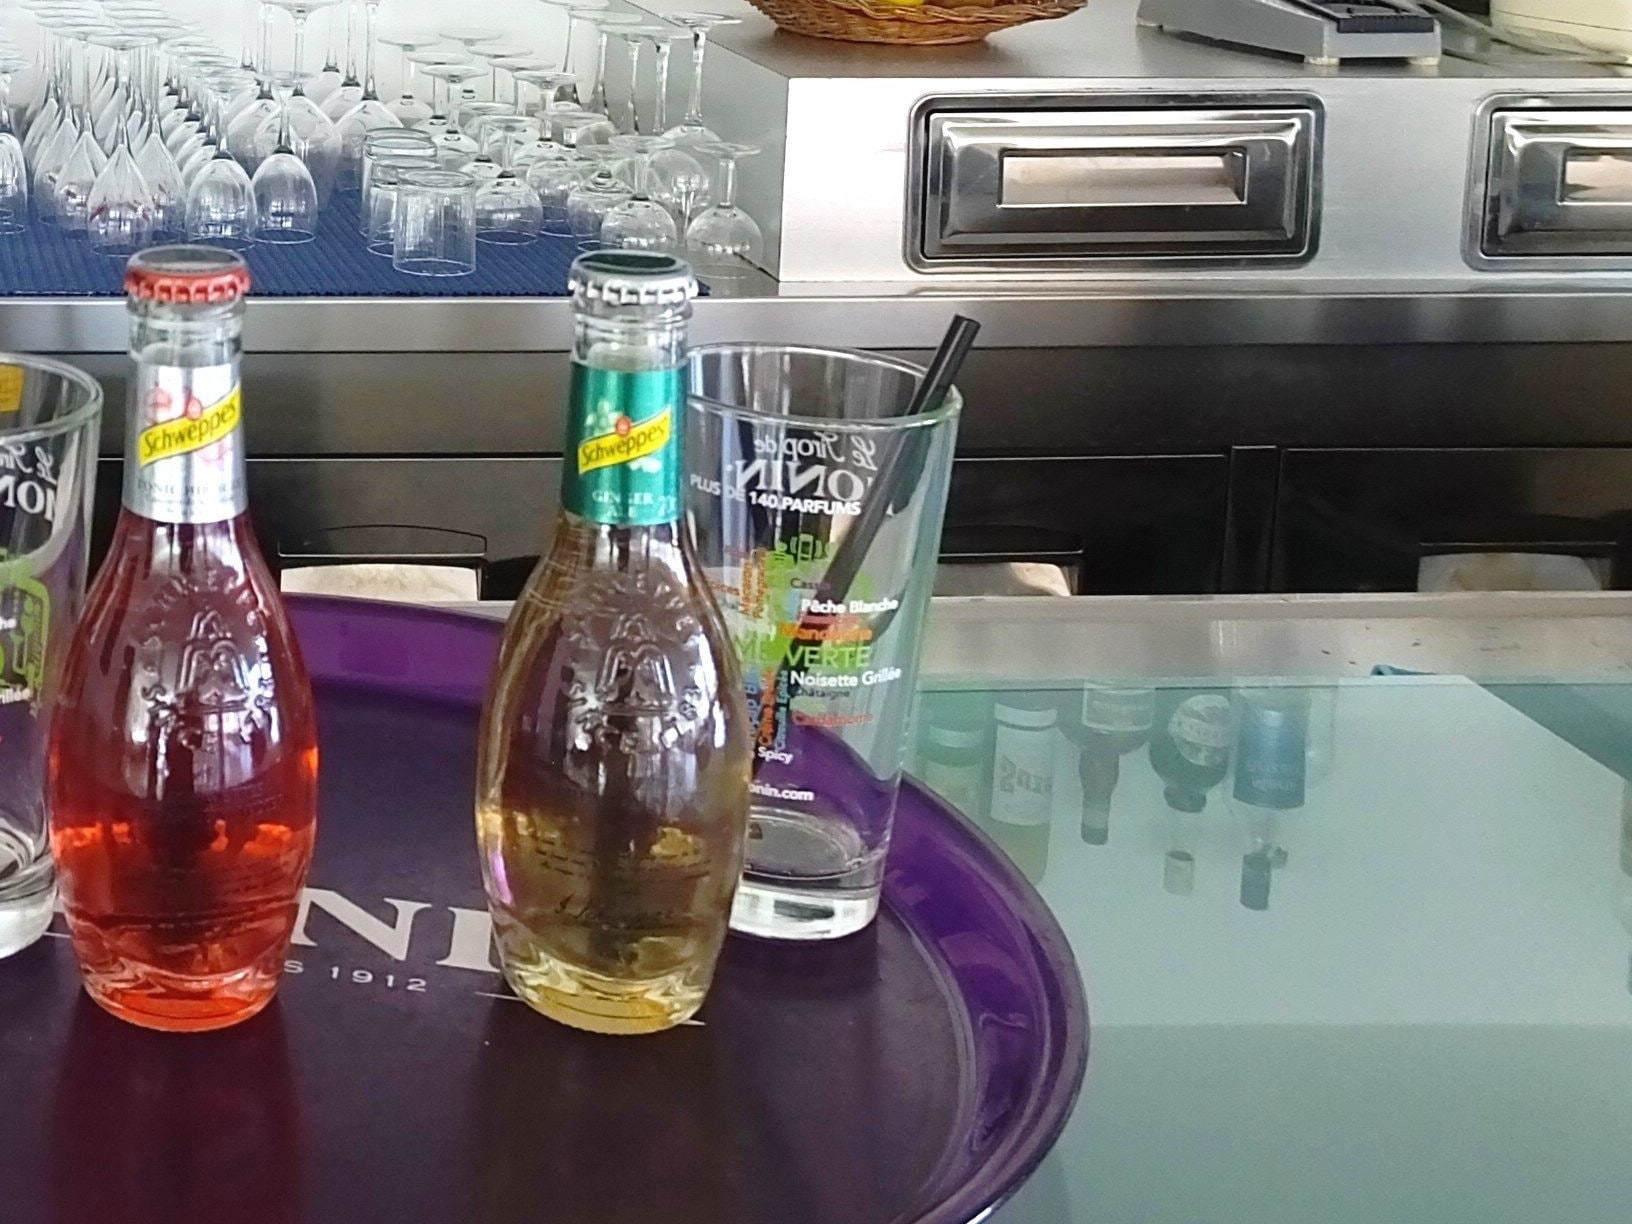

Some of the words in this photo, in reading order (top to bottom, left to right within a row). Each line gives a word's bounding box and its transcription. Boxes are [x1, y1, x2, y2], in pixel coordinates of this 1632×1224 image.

[143, 401, 237, 458] Schweppes
[581, 416, 668, 467] Schweppes
[689, 473, 722, 497] PLUS
[725, 481, 746, 503] DE
[748, 490, 779, 509] 140
[781, 496, 862, 516] PARFUMS
[800, 597, 847, 615] Pêche
[849, 596, 900, 615] Blanche
[786, 644, 872, 669] VERTE
[789, 669, 858, 687] Noisette
[861, 666, 903, 686] Grillée
[757, 746, 794, 765] Spicy
[748, 783, 815, 802] onin.com
[330, 965, 427, 993] 1912
